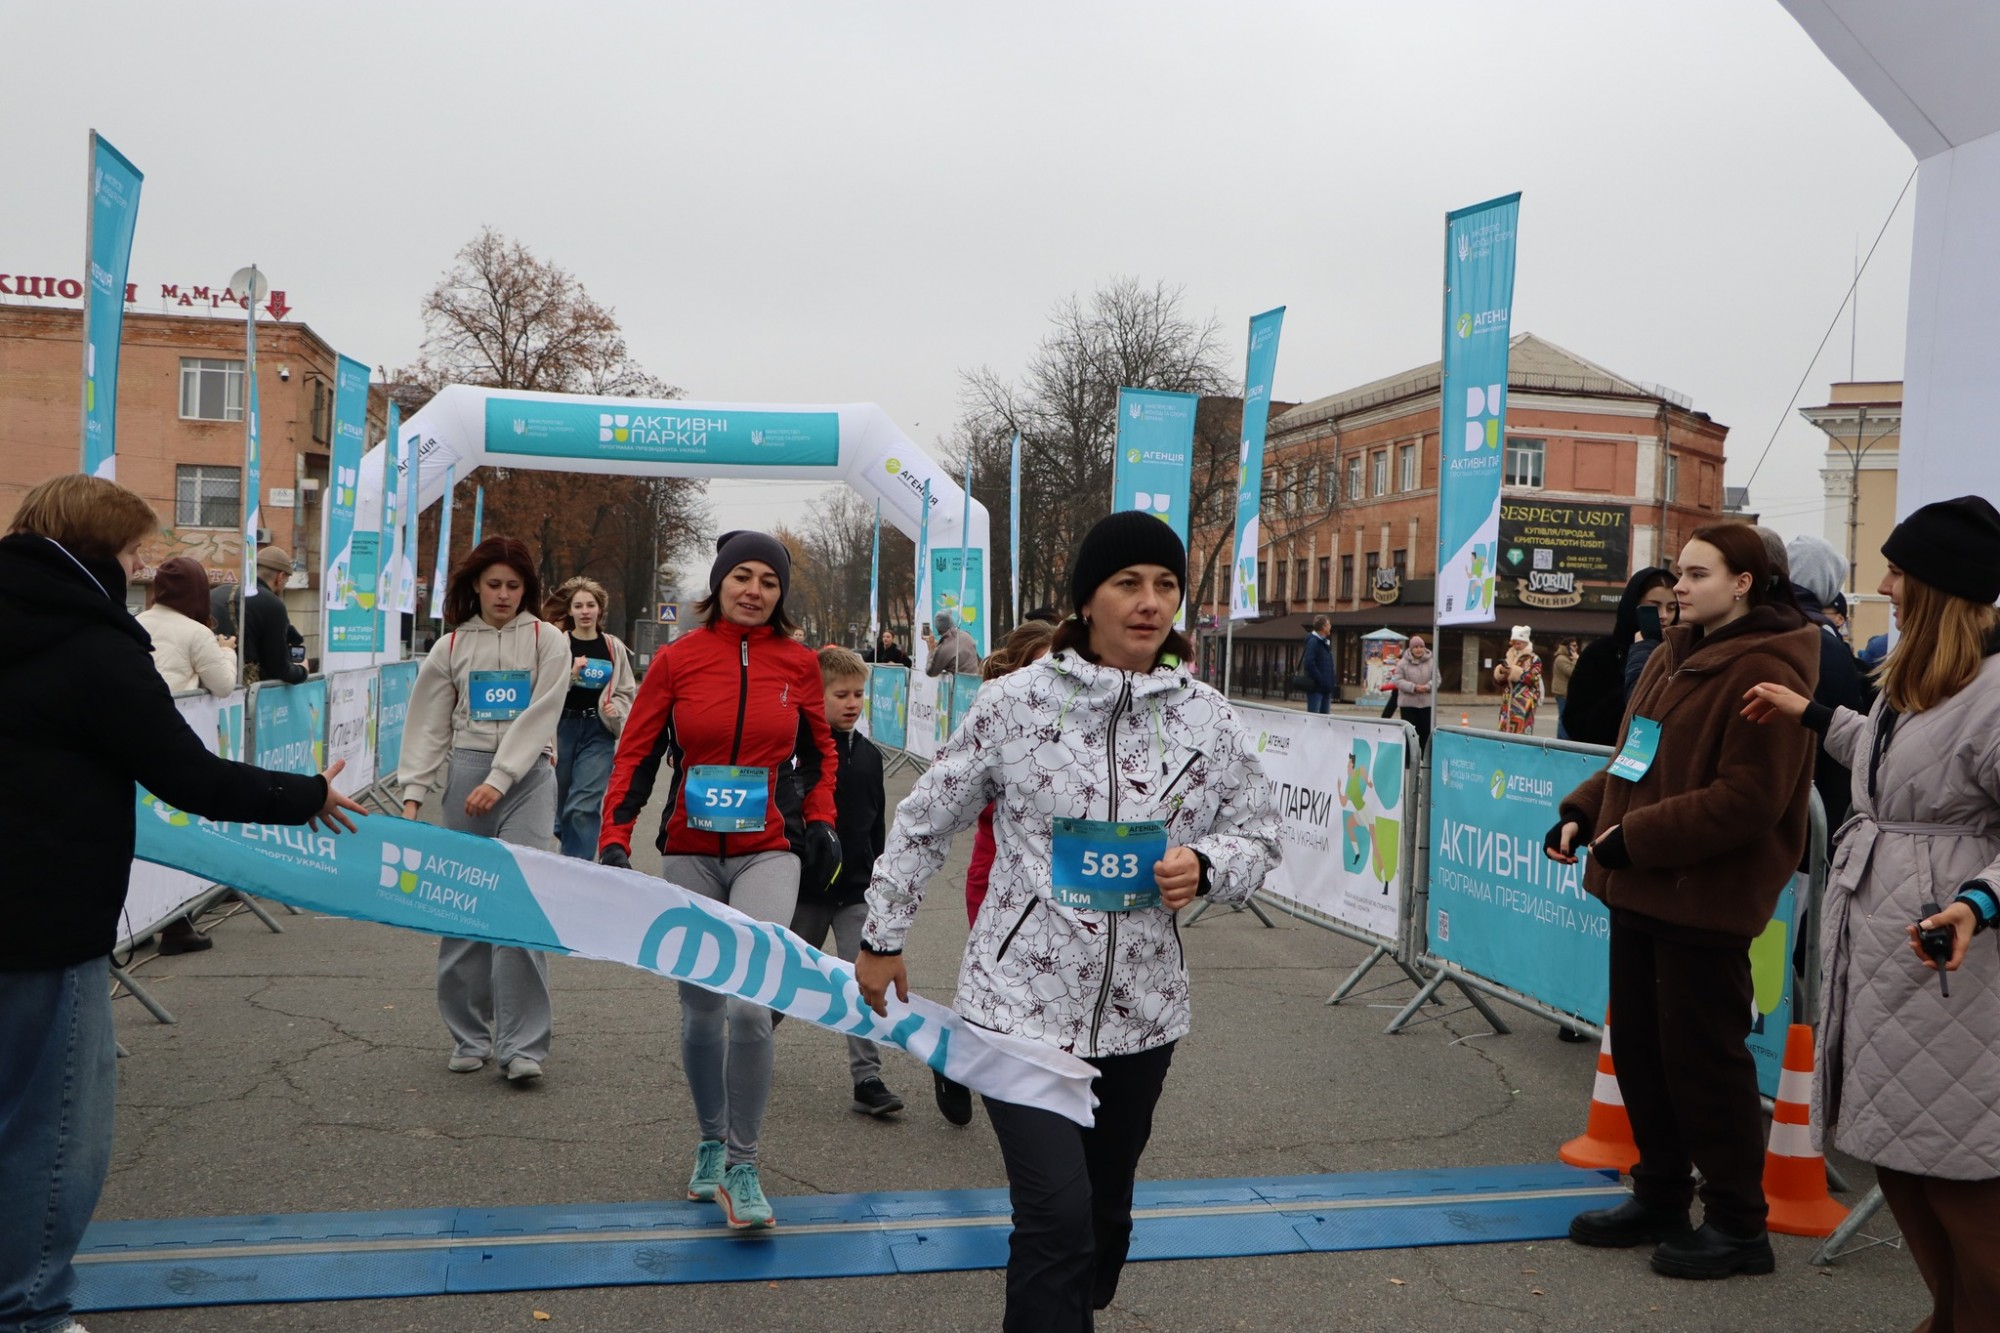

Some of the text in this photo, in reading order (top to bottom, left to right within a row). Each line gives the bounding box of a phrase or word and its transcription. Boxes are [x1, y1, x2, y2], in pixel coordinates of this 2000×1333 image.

[631, 415, 728, 433] АКТИВНІ
[631, 429, 708, 447] ПАРКИ
[397, 438, 437, 473] АГЦІЯ
[1450, 457, 1487, 471] АКТИВНІ
[900, 470, 939, 506] АГЕНІЯ
[1577, 510, 1625, 527] USDT
[1513, 536, 1580, 547] КРИПТОВАЛЮТИ
[1524, 527, 1596, 539] КУПІВЛЯ/ПРОДАЖ
[584, 668, 604, 679] 689
[485, 688, 517, 703] 690
[1506, 774, 1553, 798] АГЕНЦІЯ
[705, 788, 747, 808] 557
[1279, 783, 1332, 828] ПАРКИ
[1439, 818, 1541, 885] АКТИВНІ
[295, 857, 338, 875] УКРАЇНИ
[424, 855, 500, 891] АКТИВНІ
[1081, 851, 1138, 878] 583
[419, 881, 478, 914] ПАРКИ
[1438, 866, 1493, 903] ПРОГРАМА
[1495, 885, 1578, 931] ПРЕЗИДЕНТА
